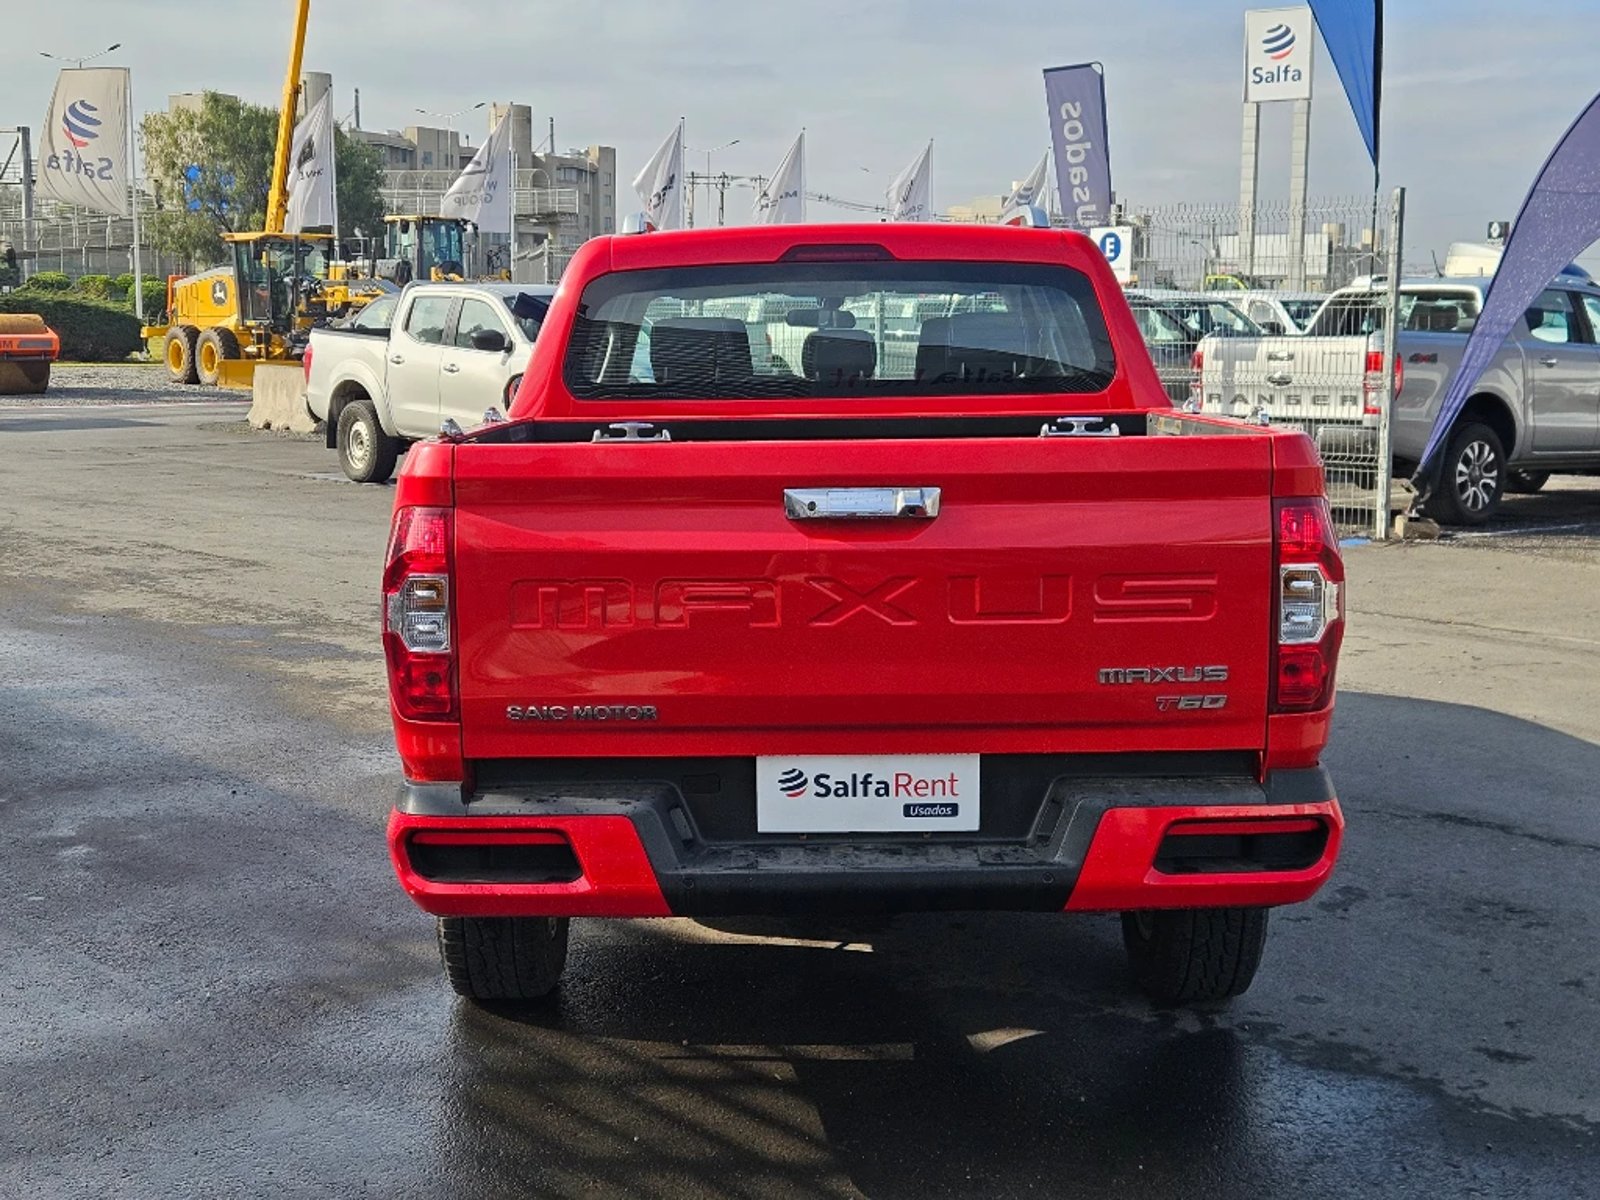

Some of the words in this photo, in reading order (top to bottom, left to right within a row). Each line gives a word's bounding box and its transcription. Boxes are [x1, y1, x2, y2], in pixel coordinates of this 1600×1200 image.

[1252, 64, 1303, 85] Salfa
[1105, 236, 1116, 257] E
[1207, 393, 1359, 406] RANGER
[508, 573, 1218, 629] MAXUS
[1098, 665, 1229, 684] MAXUS
[1155, 694, 1228, 711] T60
[506, 704, 567, 720] SAIC
[572, 704, 657, 720] MOTOR
[910, 804, 953, 816] Usados
